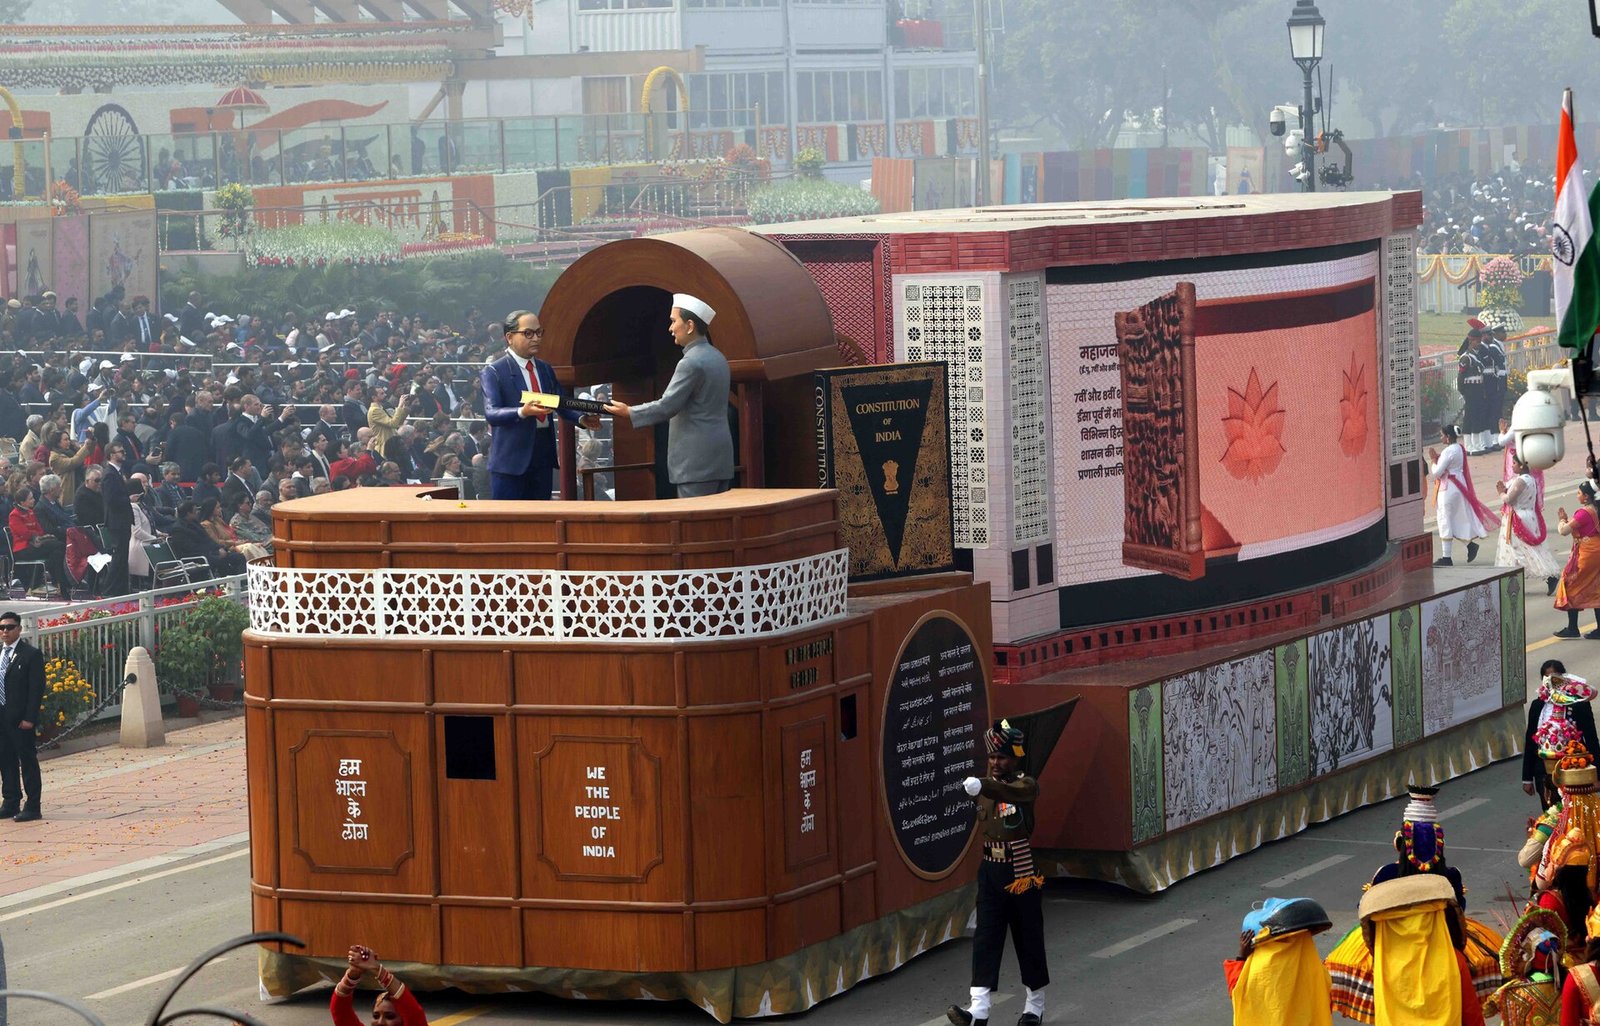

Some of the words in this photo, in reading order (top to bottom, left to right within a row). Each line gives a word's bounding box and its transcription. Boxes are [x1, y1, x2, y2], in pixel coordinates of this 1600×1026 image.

[1079, 344, 1120, 361] महाजन
[1074, 388, 1088, 403] 7वीं
[1088, 387, 1102, 401] और
[1103, 386, 1117, 400] 8वीं
[855, 398, 920, 415] CONSTITUTION
[1076, 408, 1092, 423] ईसा
[1092, 407, 1105, 424] पूर्व
[1104, 406, 1113, 419] में
[1112, 408, 1123, 418] भा
[882, 417, 892, 426] OF
[875, 430, 902, 443] INDIA
[1081, 426, 1109, 441] विभिन्न
[1081, 448, 1104, 460] शासन
[1104, 444, 1115, 458] की
[1078, 464, 1104, 480] प्रणाली
[1103, 462, 1125, 478] प्रचलि
[338, 758, 363, 776] हम
[800, 749, 812, 769] हम
[586, 766, 606, 780] WE
[800, 769, 817, 789] भारत
[335, 778, 368, 797] भारत
[585, 786, 610, 799] THE
[347, 797, 361, 818] के
[803, 789, 812, 810] के
[574, 805, 621, 820] PEOPLE
[341, 818, 369, 841] लोग
[800, 811, 815, 834] लोग
[591, 825, 607, 839] OF
[582, 845, 616, 858] INDIA
